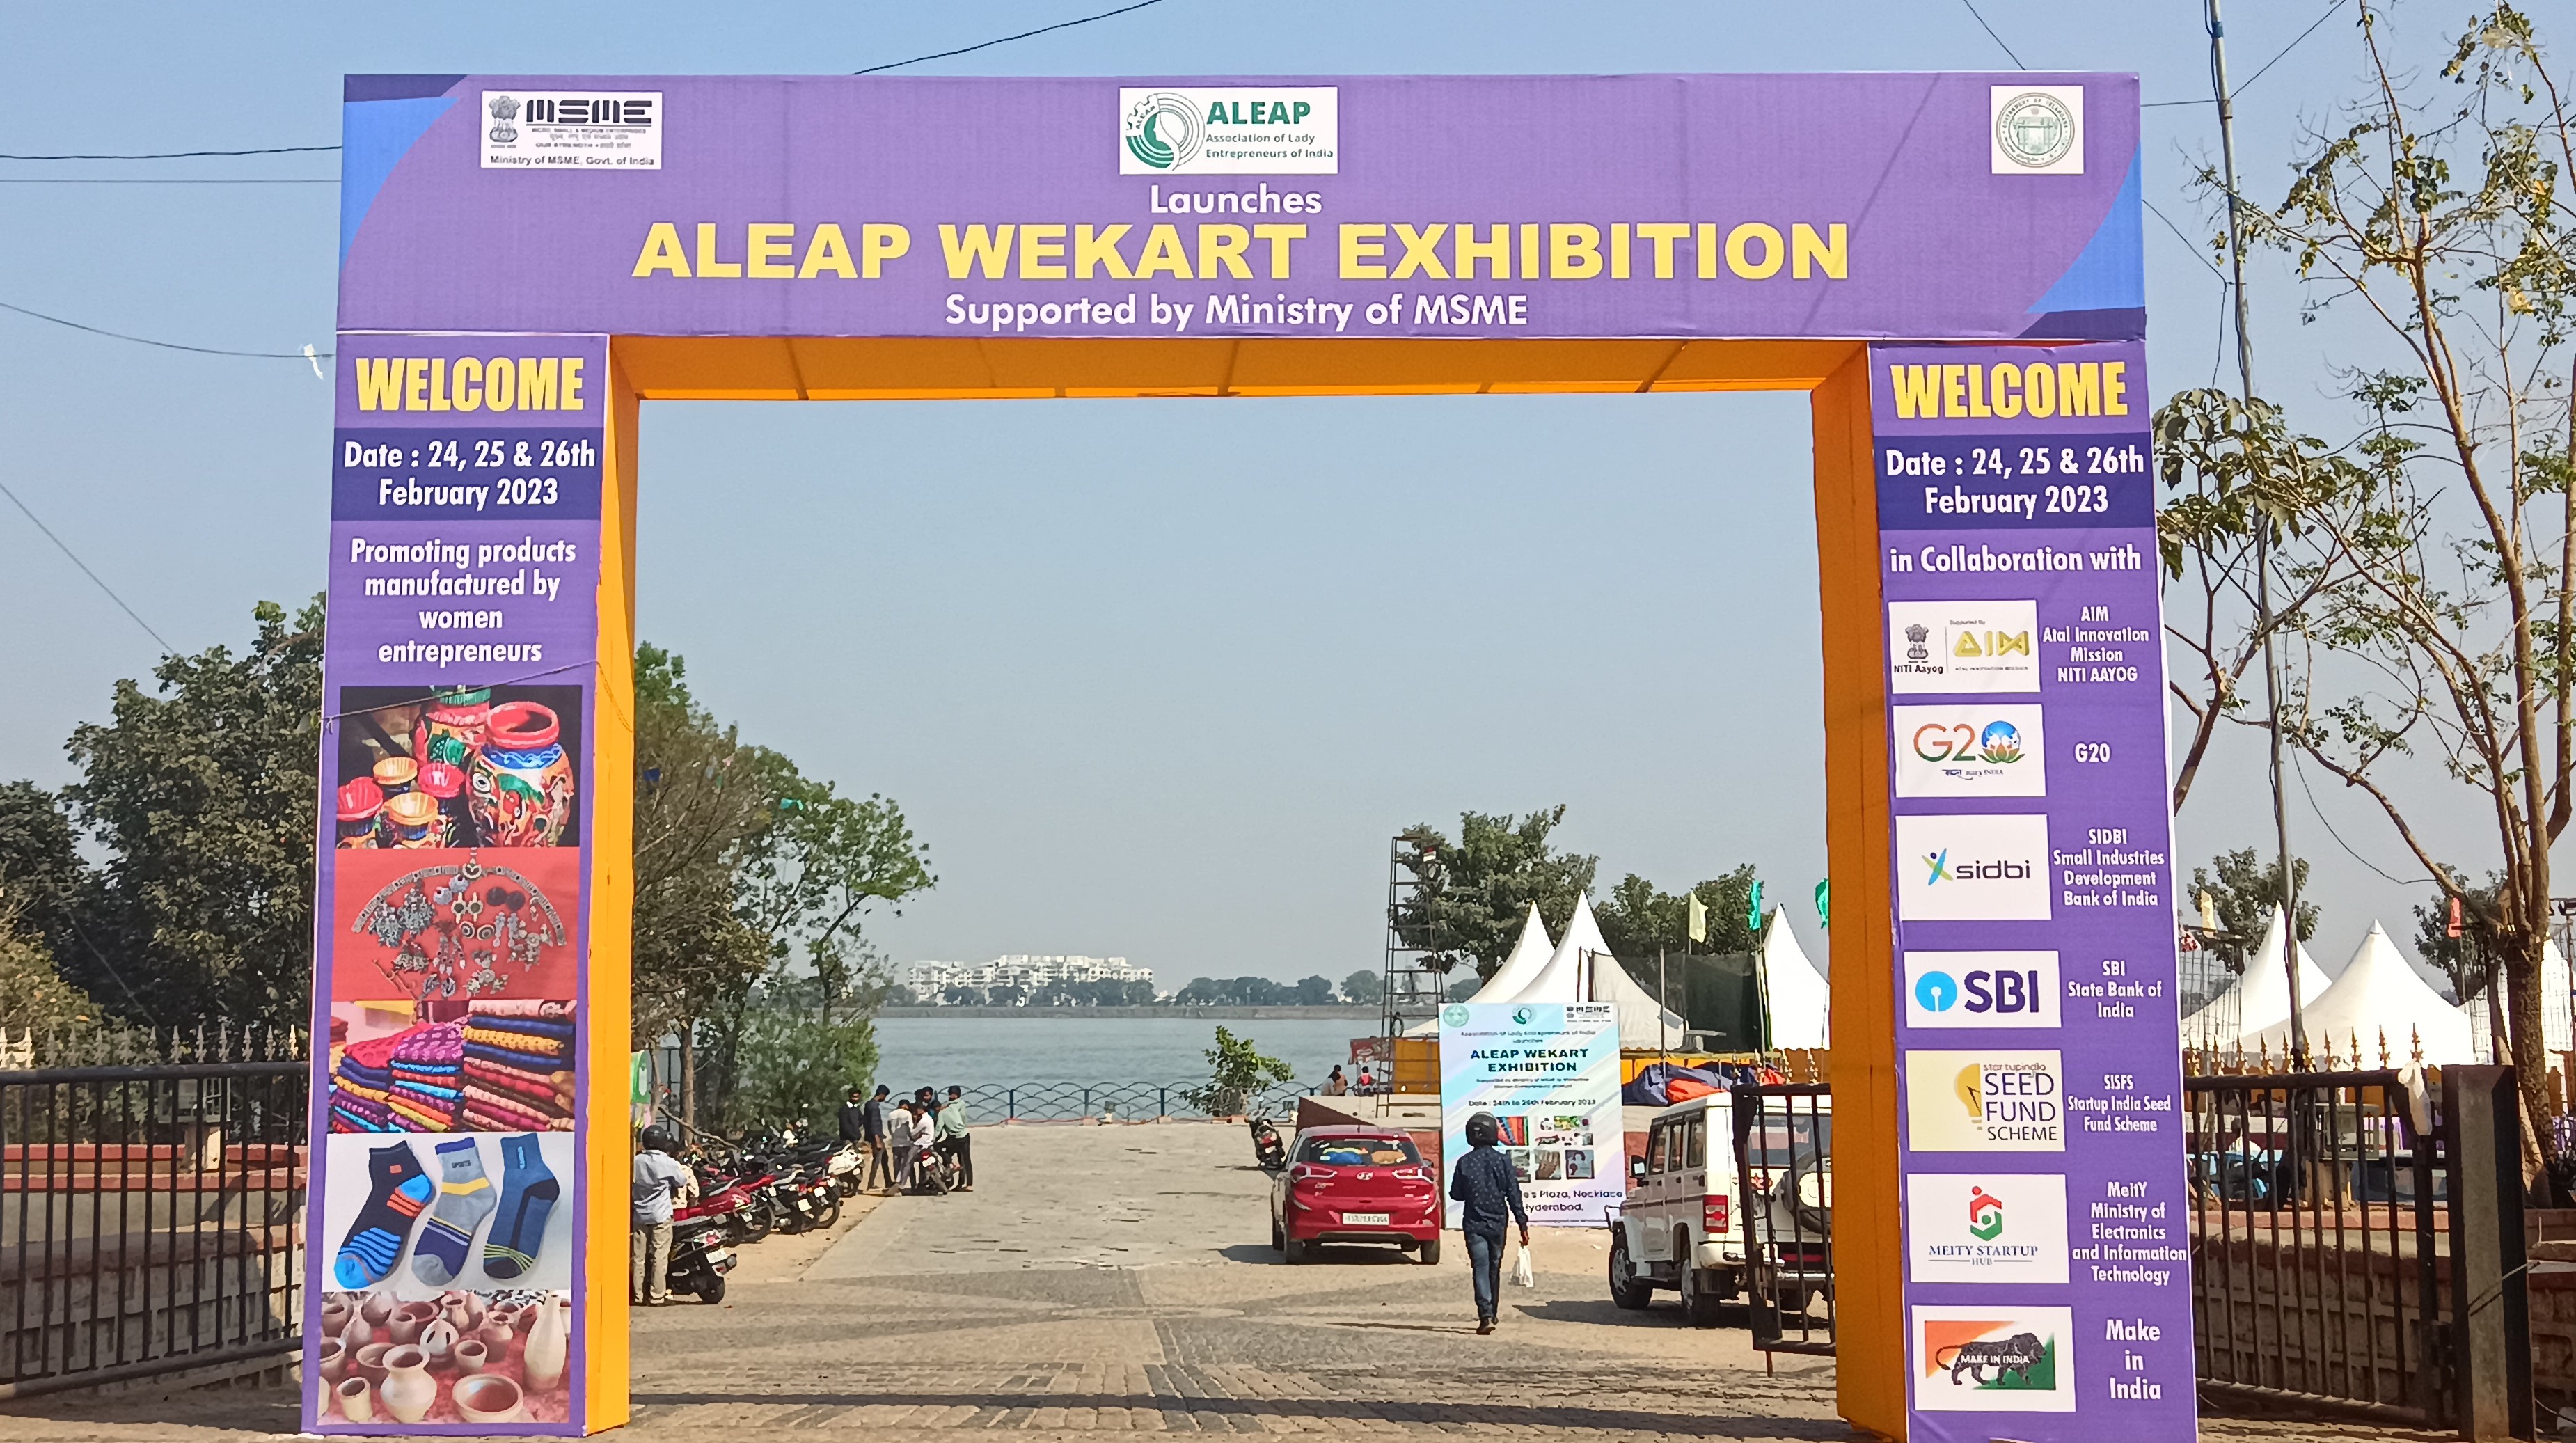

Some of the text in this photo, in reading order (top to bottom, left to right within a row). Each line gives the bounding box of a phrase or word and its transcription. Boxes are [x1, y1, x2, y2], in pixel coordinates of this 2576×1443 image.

[526, 100, 652, 123] MSME
[1206, 102, 1311, 125] ALEAP
[1206, 134, 1315, 145] Association of Lady
[491, 156, 532, 166] Ministry
[535, 155, 545, 164] of
[630, 157, 654, 165] India
[1206, 149, 1334, 159] Entrepreneurs of India
[1151, 181, 1322, 214] Launches
[631, 221, 1848, 279] ALEAP WEKART EXHIBITION
[946, 292, 1528, 332] Supported by Ministry of MSME
[356, 356, 584, 411] WELCOME
[1890, 361, 2128, 418] WELCOME
[345, 439, 594, 471] Date : 24, 25 & 26th
[1886, 445, 2144, 479] Date : 24, 25 & 26th
[379, 478, 558, 512] February 2023
[1925, 485, 2108, 519] February 2023
[351, 536, 576, 569] Promoting products
[1890, 544, 2141, 572] in Collaboration with
[365, 569, 560, 601] manufactured by
[418, 610, 503, 629] women
[2081, 606, 2109, 622] AIM
[1954, 631, 2029, 656] AIM
[2042, 626, 2149, 642] Atal Innovation
[378, 640, 542, 668] entrepreneurs
[2071, 646, 2123, 662] Mission
[1894, 665, 1943, 674] NITI Aayog
[2057, 667, 2138, 683] NITI AAYOG
[2075, 743, 2110, 762] G20
[2089, 829, 2127, 844] SIDBI
[2053, 849, 2165, 865] Small Industries
[1956, 860, 2030, 879] sidbi
[2064, 870, 2156, 888] Development
[2064, 890, 2158, 906] Bank of India
[2102, 961, 2126, 976] SBI
[1964, 970, 2039, 1013] SBI
[2068, 980, 2162, 997] State Bank of
[2097, 1002, 2134, 1018] India
[1471, 1048, 1589, 1059] ALEAP WEKART
[1488, 1062, 1577, 1072] EXHIBITION
[1985, 1073, 2054, 1095] SEED
[2104, 1074, 2134, 1091] SISFS
[1986, 1101, 2055, 1121] FUND
[2068, 1095, 2171, 1114] Startup India Seed
[1988, 1126, 2057, 1140] SCHEME
[2084, 1116, 2158, 1132] Fund Scheme
[1540, 1190, 1571, 1199] Plaza,
[2108, 1181, 2148, 1198] MeitY
[2091, 1202, 2166, 1222] Ministry of
[2092, 1223, 2166, 1240] Electronics
[1929, 1245, 2038, 1256] MEITY STARTUP
[2072, 1244, 2187, 1261] and Information
[2091, 1265, 2170, 1285] Technology
[2105, 1318, 2160, 1341] Make
[1961, 1355, 1988, 1363] MAKE
[2003, 1355, 2030, 1363] INDIA
[2124, 1350, 2144, 1371] in
[2110, 1377, 2161, 1400] India
